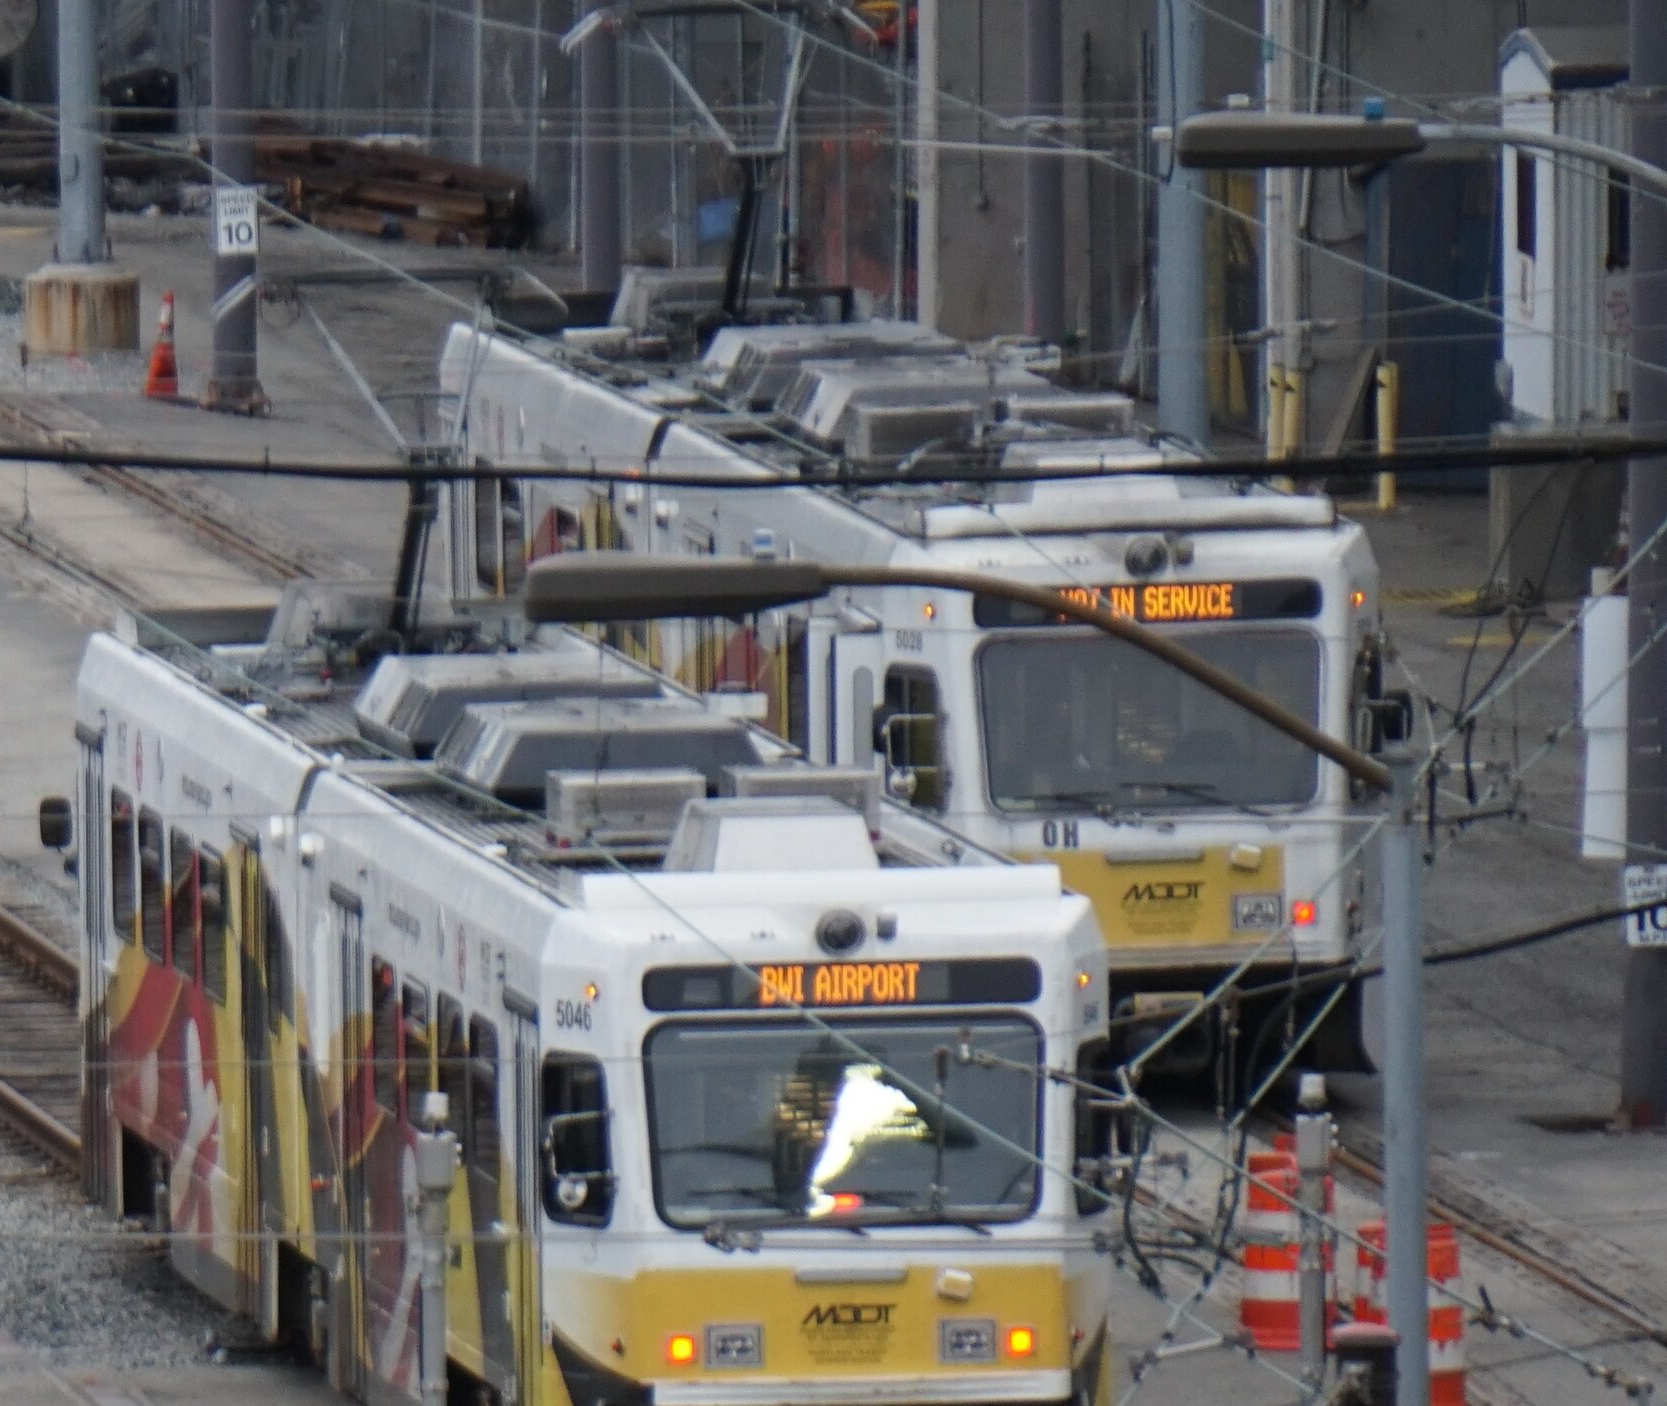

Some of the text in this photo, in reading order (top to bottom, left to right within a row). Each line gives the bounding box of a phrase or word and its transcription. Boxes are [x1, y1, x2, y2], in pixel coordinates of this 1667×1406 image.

[223, 221, 253, 245] 10
[1109, 586, 1135, 619] IN
[1142, 582, 1234, 619] SERVICE
[1042, 819, 1079, 849] OH
[761, 961, 920, 1005] BWI AIRPORT
[557, 999, 592, 1031] 5046
